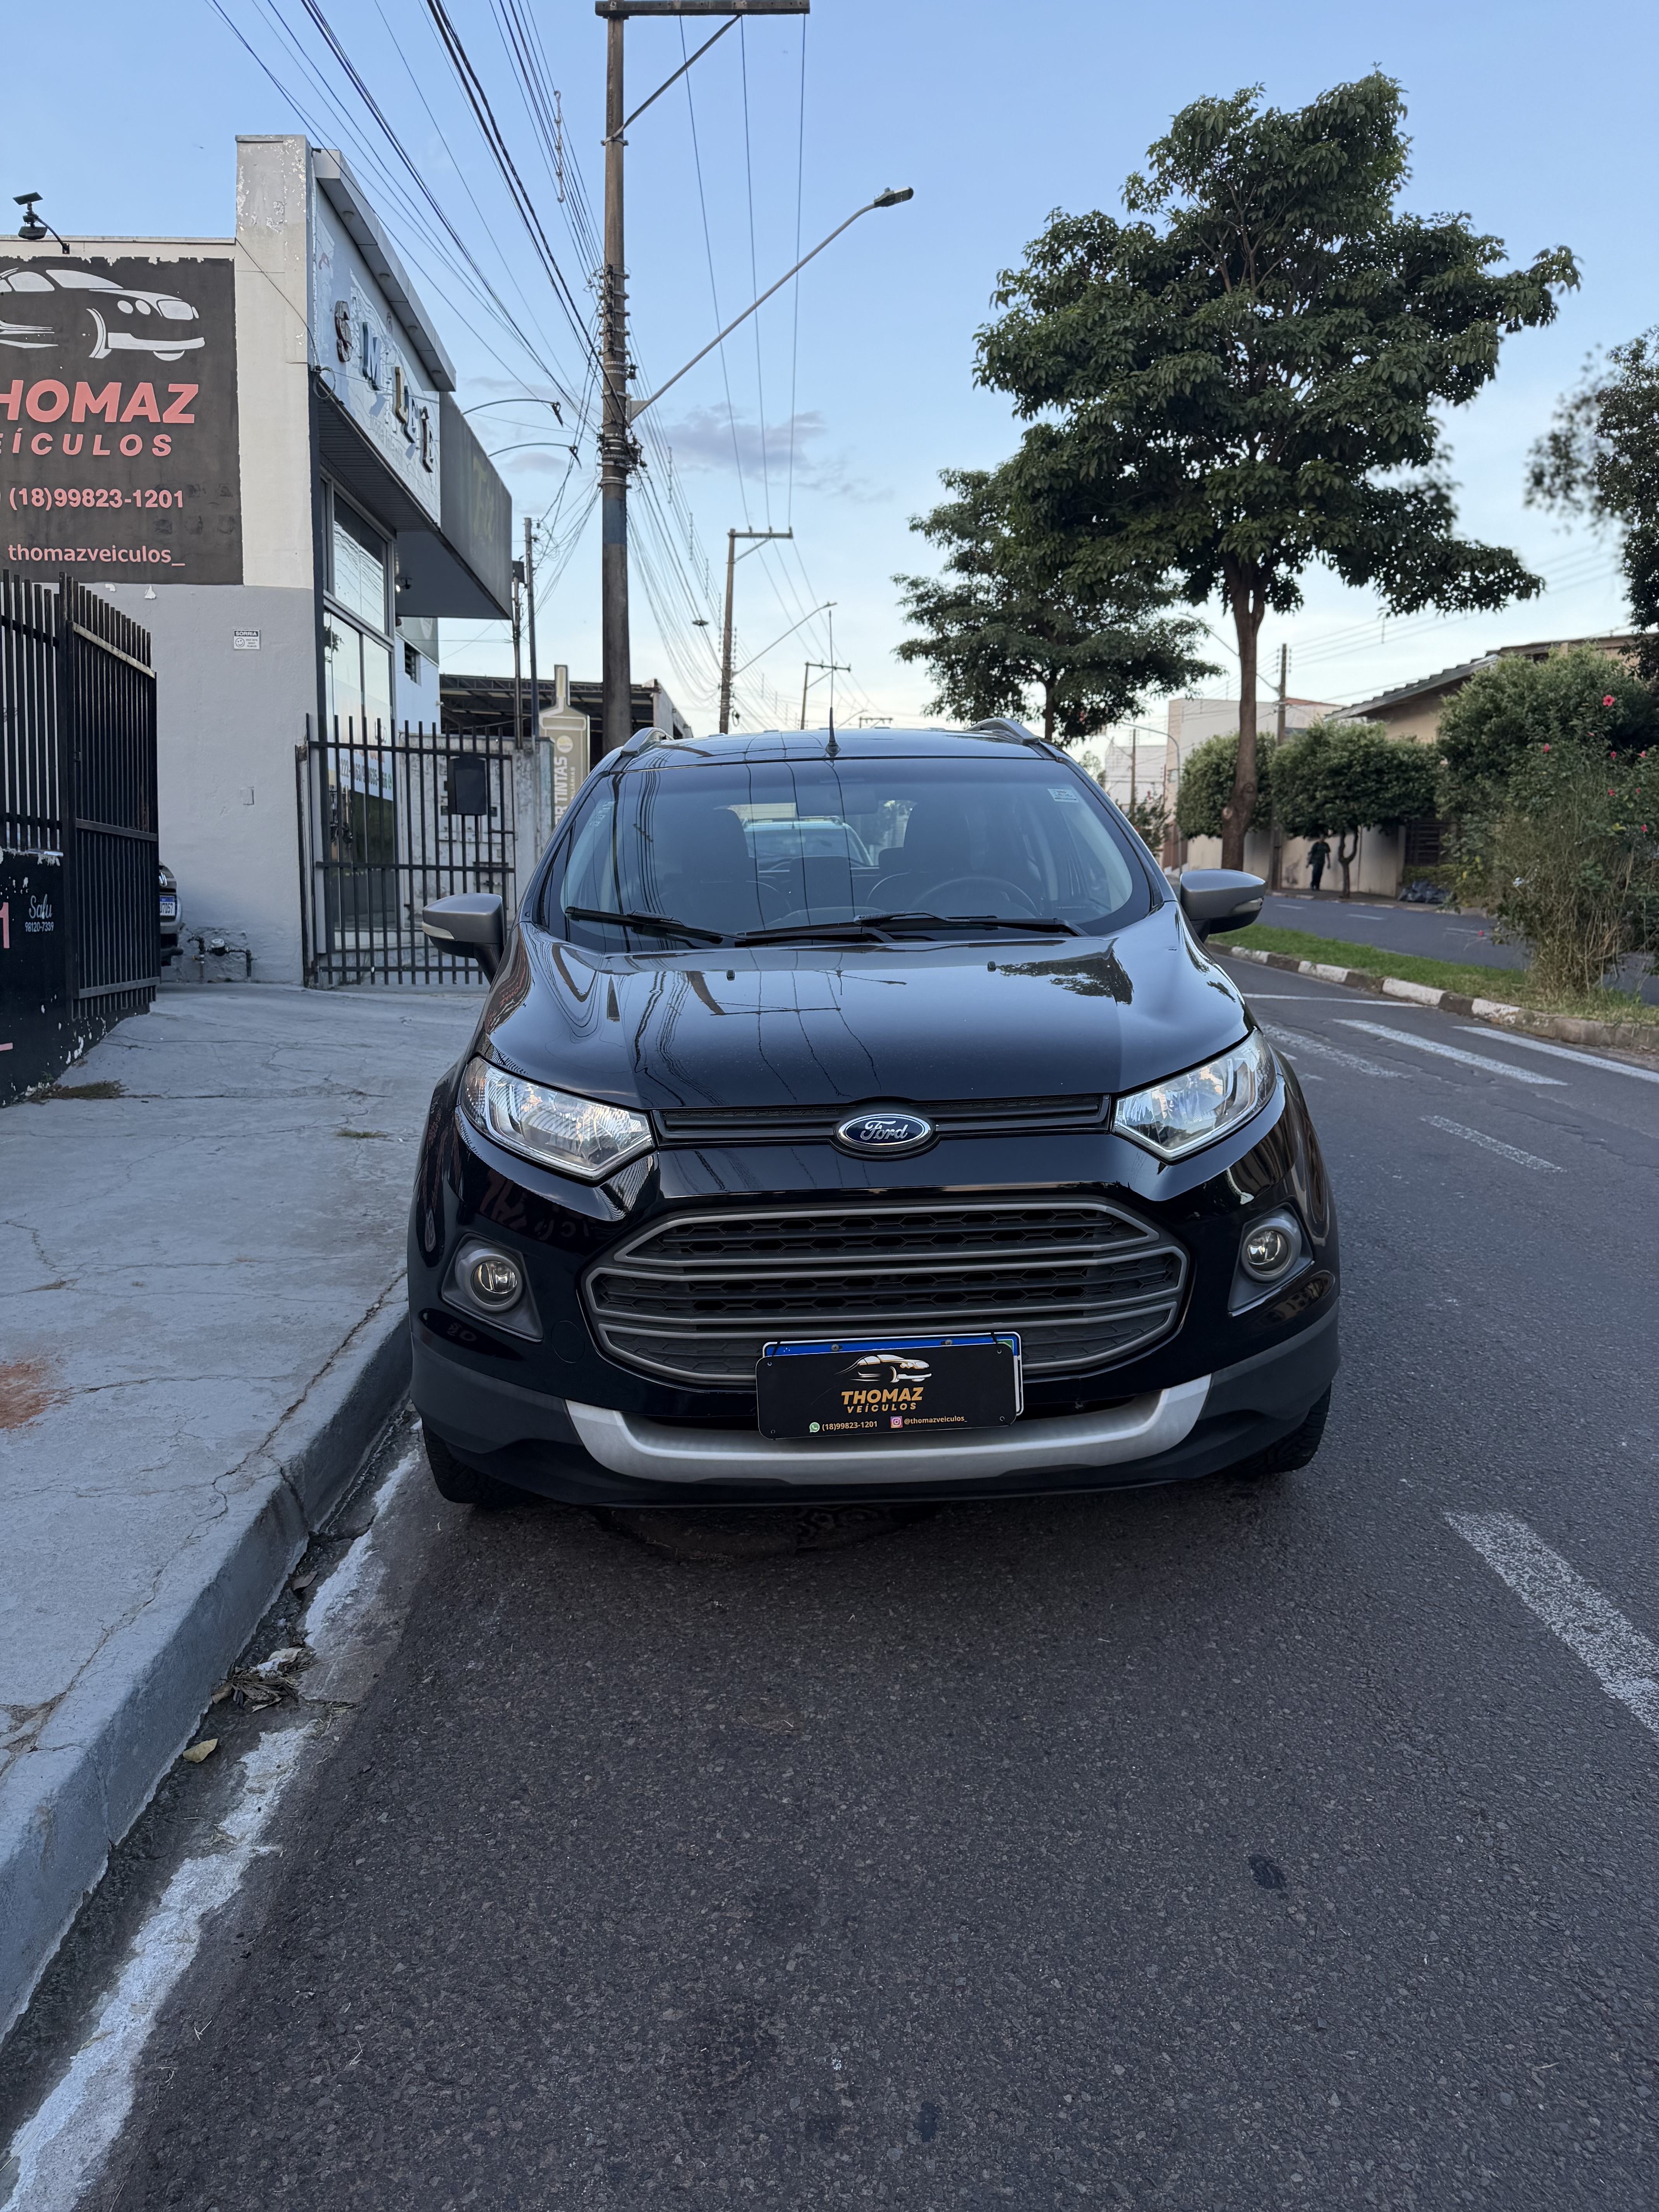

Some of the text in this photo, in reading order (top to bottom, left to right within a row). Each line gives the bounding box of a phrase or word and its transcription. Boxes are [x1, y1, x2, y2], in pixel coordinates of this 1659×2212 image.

[0, 428, 172, 457] ÍCULOS
[10, 488, 184, 510] (18)99823-1201
[9, 544, 185, 566] thomazveiculos_
[554, 756, 567, 804] TINTAS
[860, 1120, 908, 1140] Ford
[841, 1387, 924, 1405] THOMAZ
[847, 1401, 916, 1413] VEÍCULOS
[822, 1415, 968, 1431] (18)99823-1201 @thomazveiculos_
